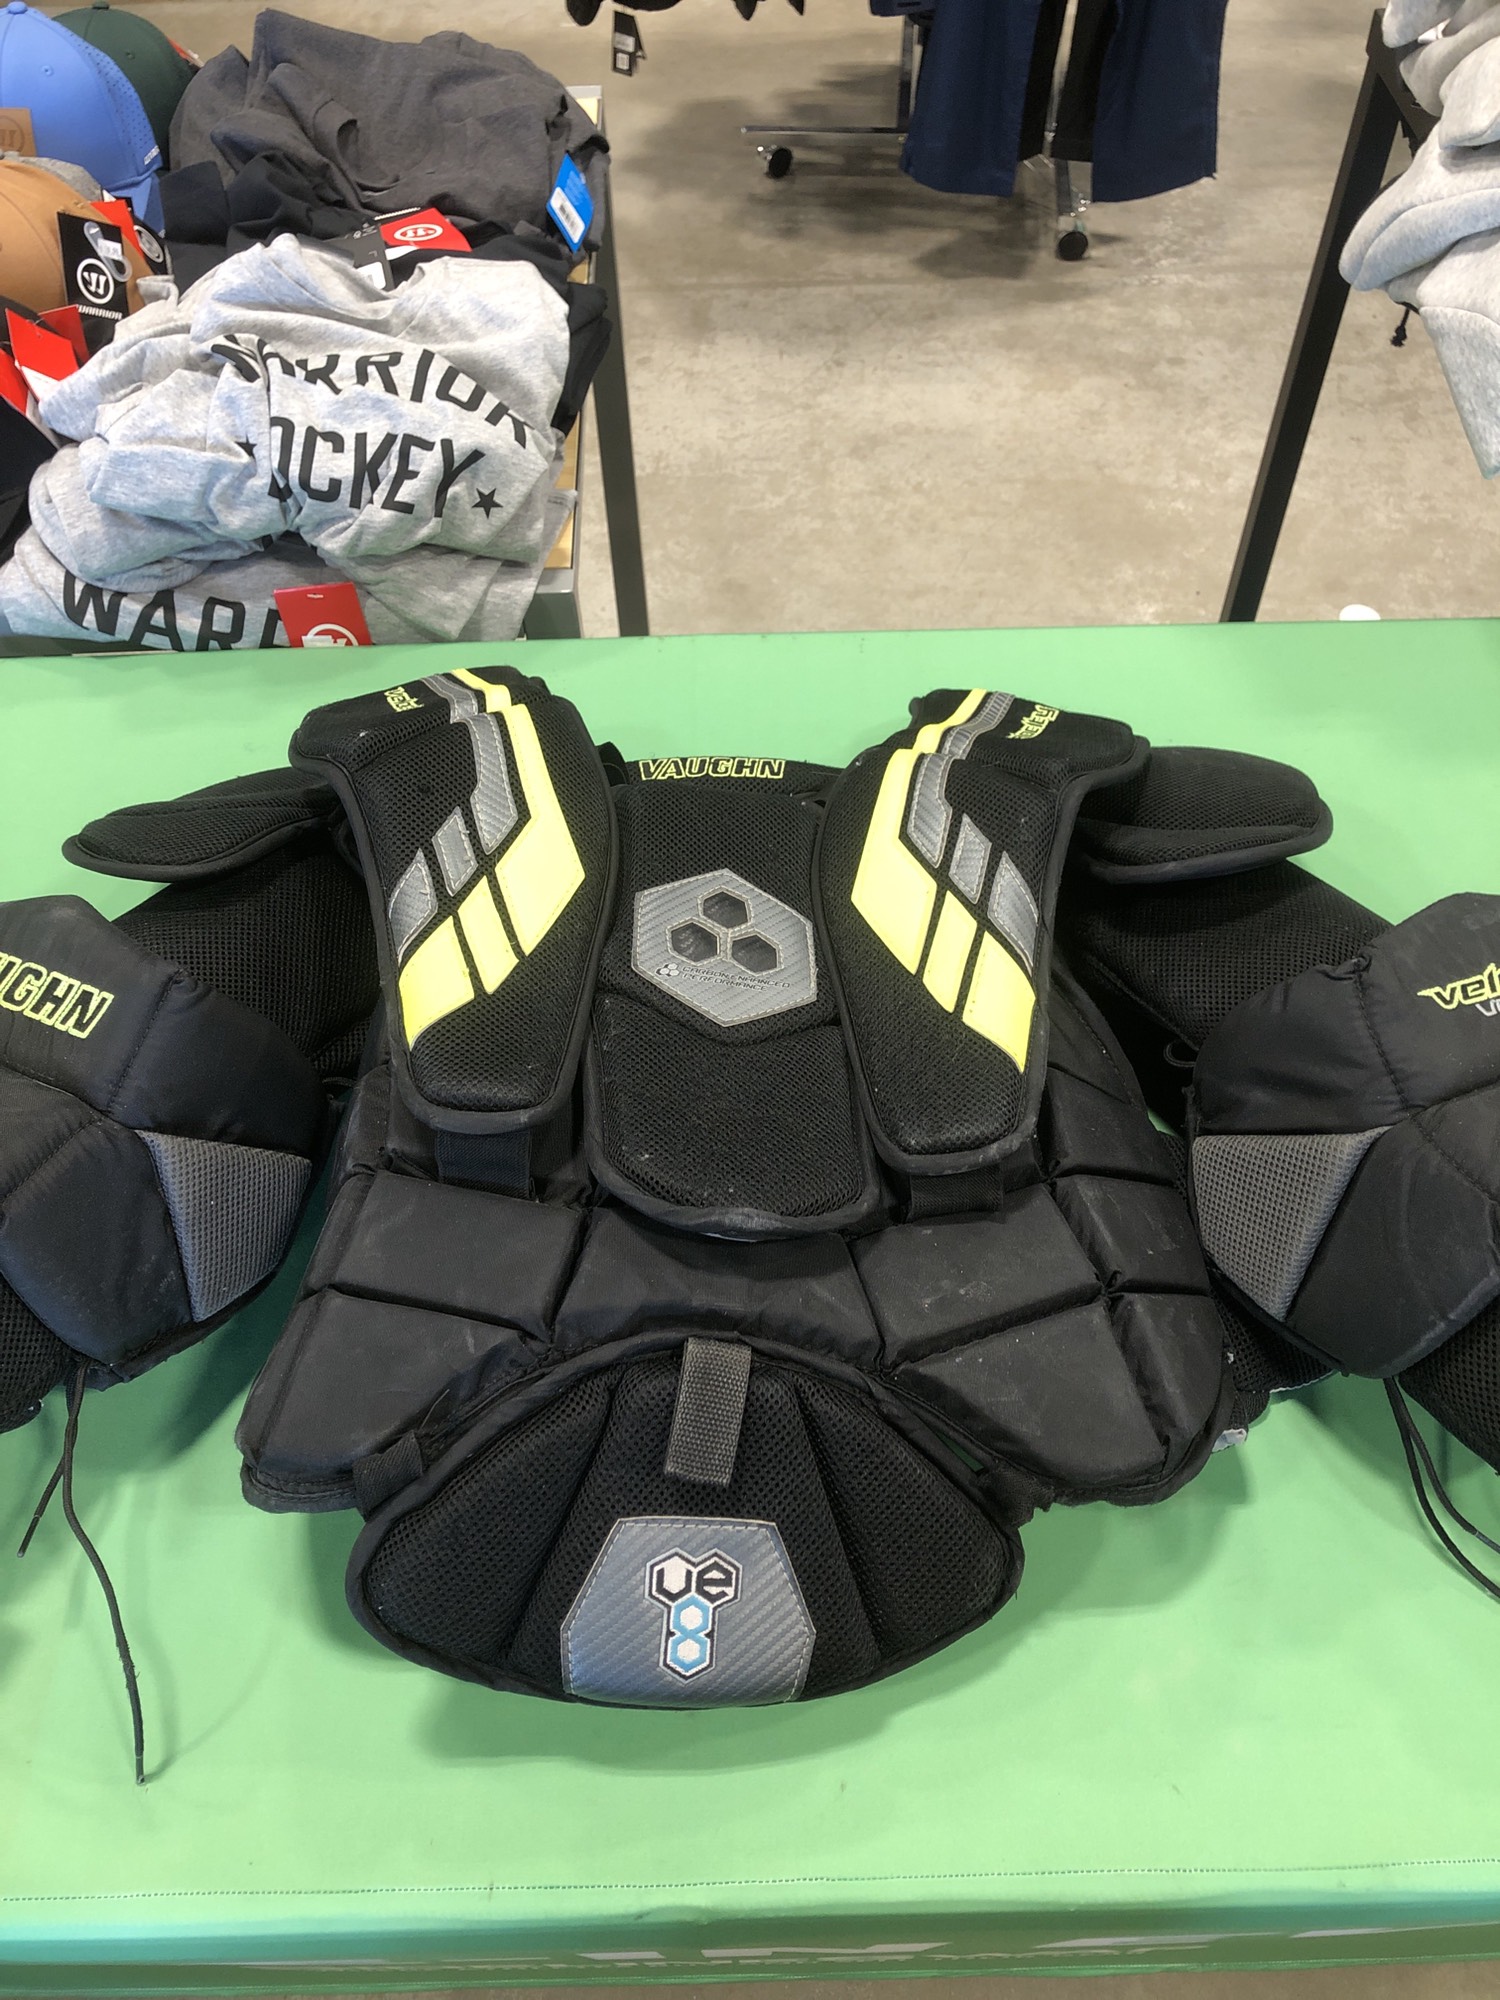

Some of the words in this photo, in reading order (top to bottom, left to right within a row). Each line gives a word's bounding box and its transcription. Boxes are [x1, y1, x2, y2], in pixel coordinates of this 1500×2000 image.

[210, 335, 535, 450] RRIO
[267, 416, 486, 518] OCKEY
[638, 756, 786, 781] VAUGHN
